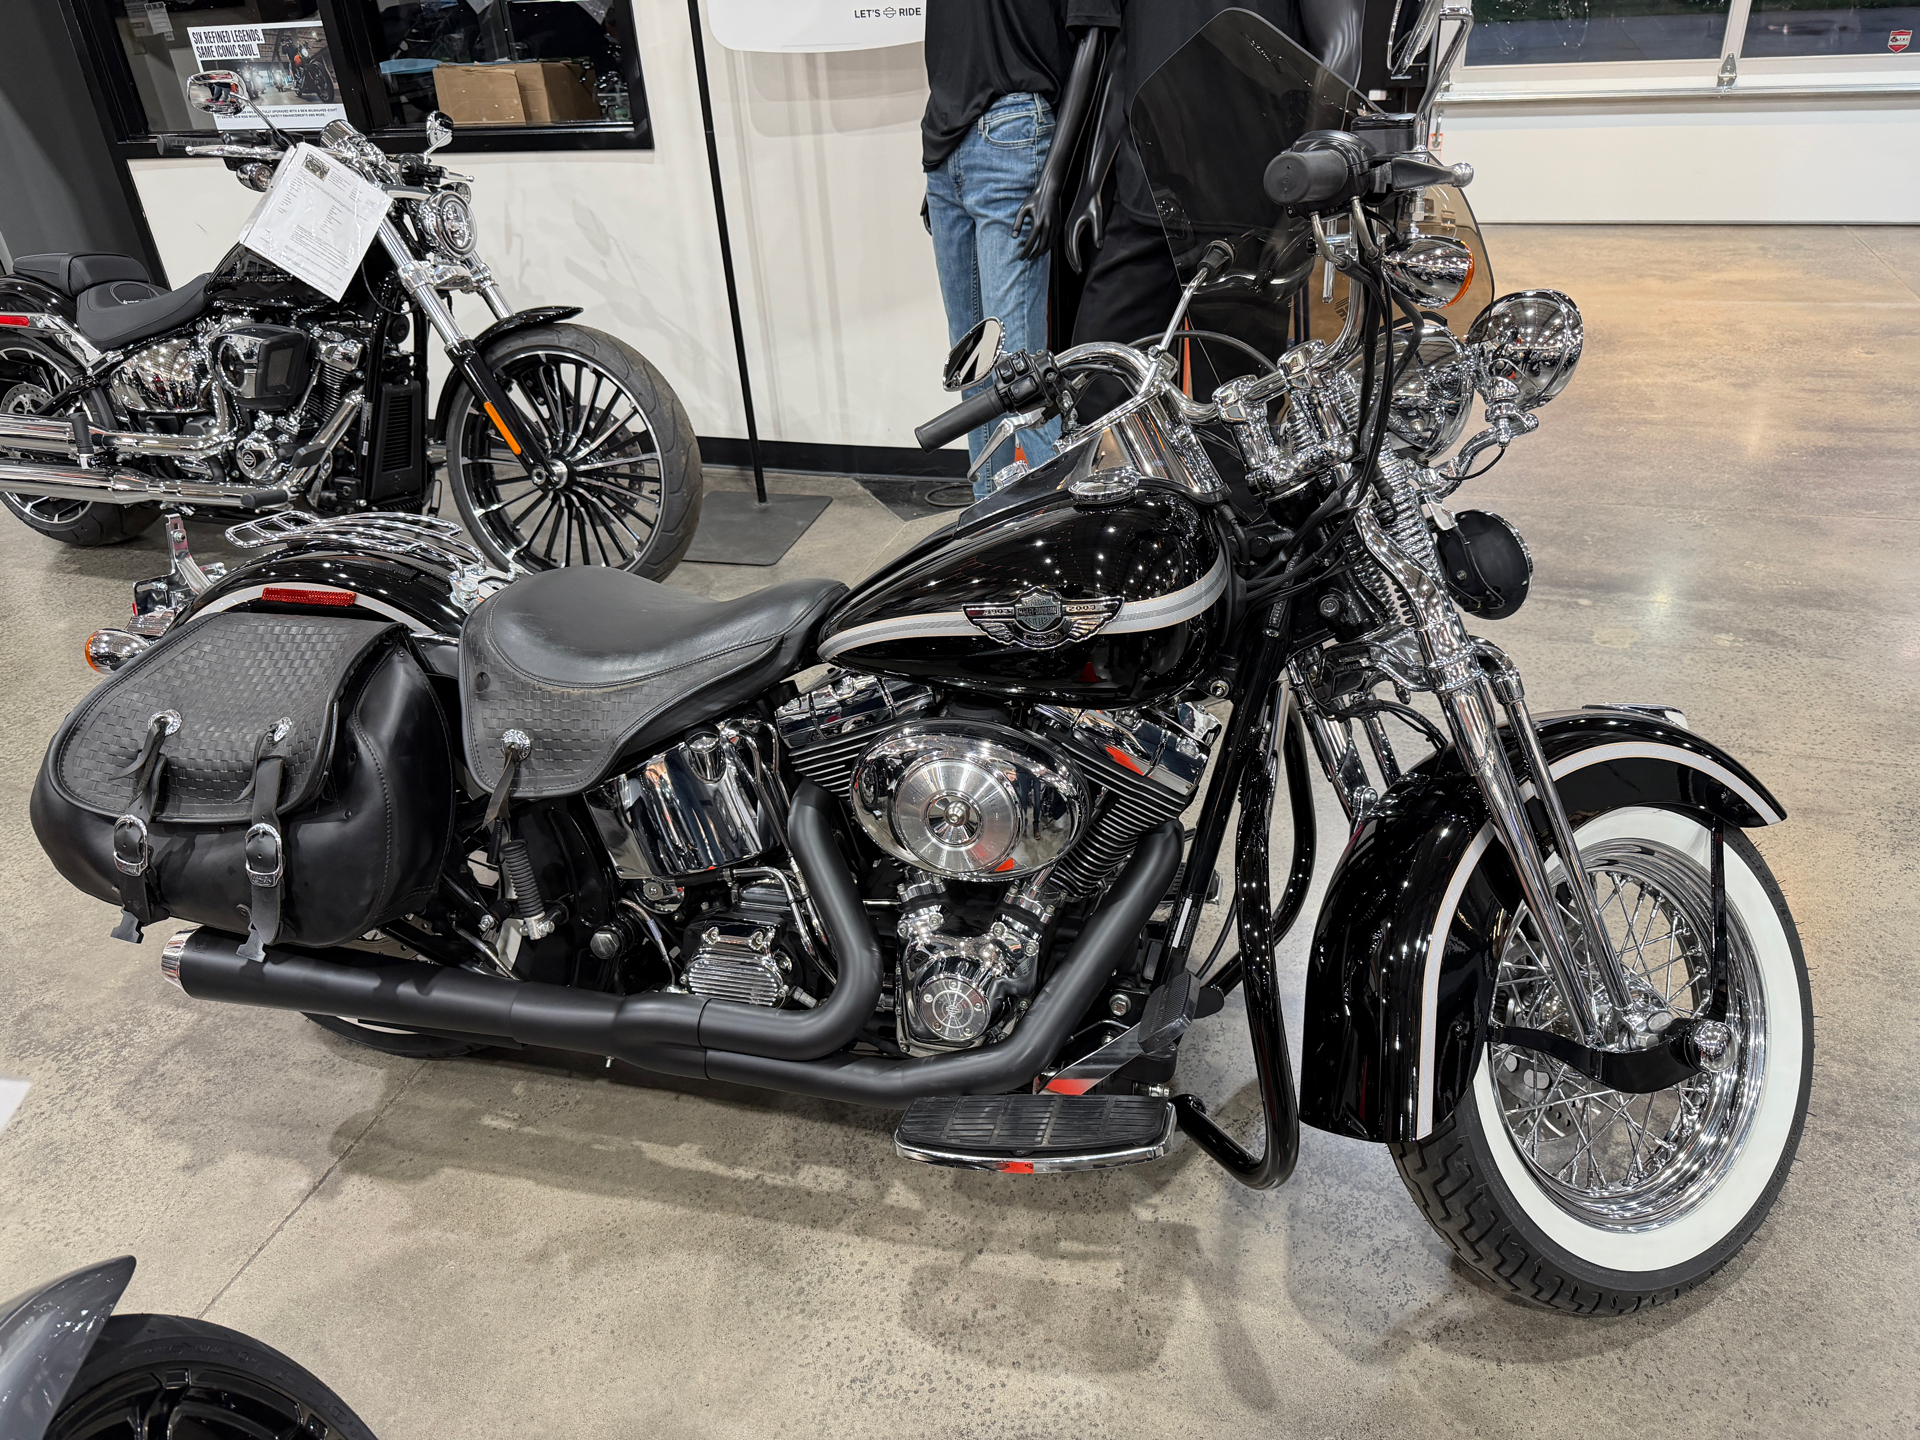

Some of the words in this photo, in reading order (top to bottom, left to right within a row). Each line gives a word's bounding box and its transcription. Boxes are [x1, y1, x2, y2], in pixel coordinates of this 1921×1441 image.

[854, 9, 881, 18] LET'S
[899, 7, 922, 16] RIDE
[192, 31, 205, 44] SIX
[203, 30, 231, 44] REFINED
[230, 28, 263, 43] LEGENDS.
[196, 45, 216, 58] SAME
[215, 44, 239, 57] ICONIC
[238, 43, 259, 57] SOUL.
[1067, 604, 1096, 612] 2003
